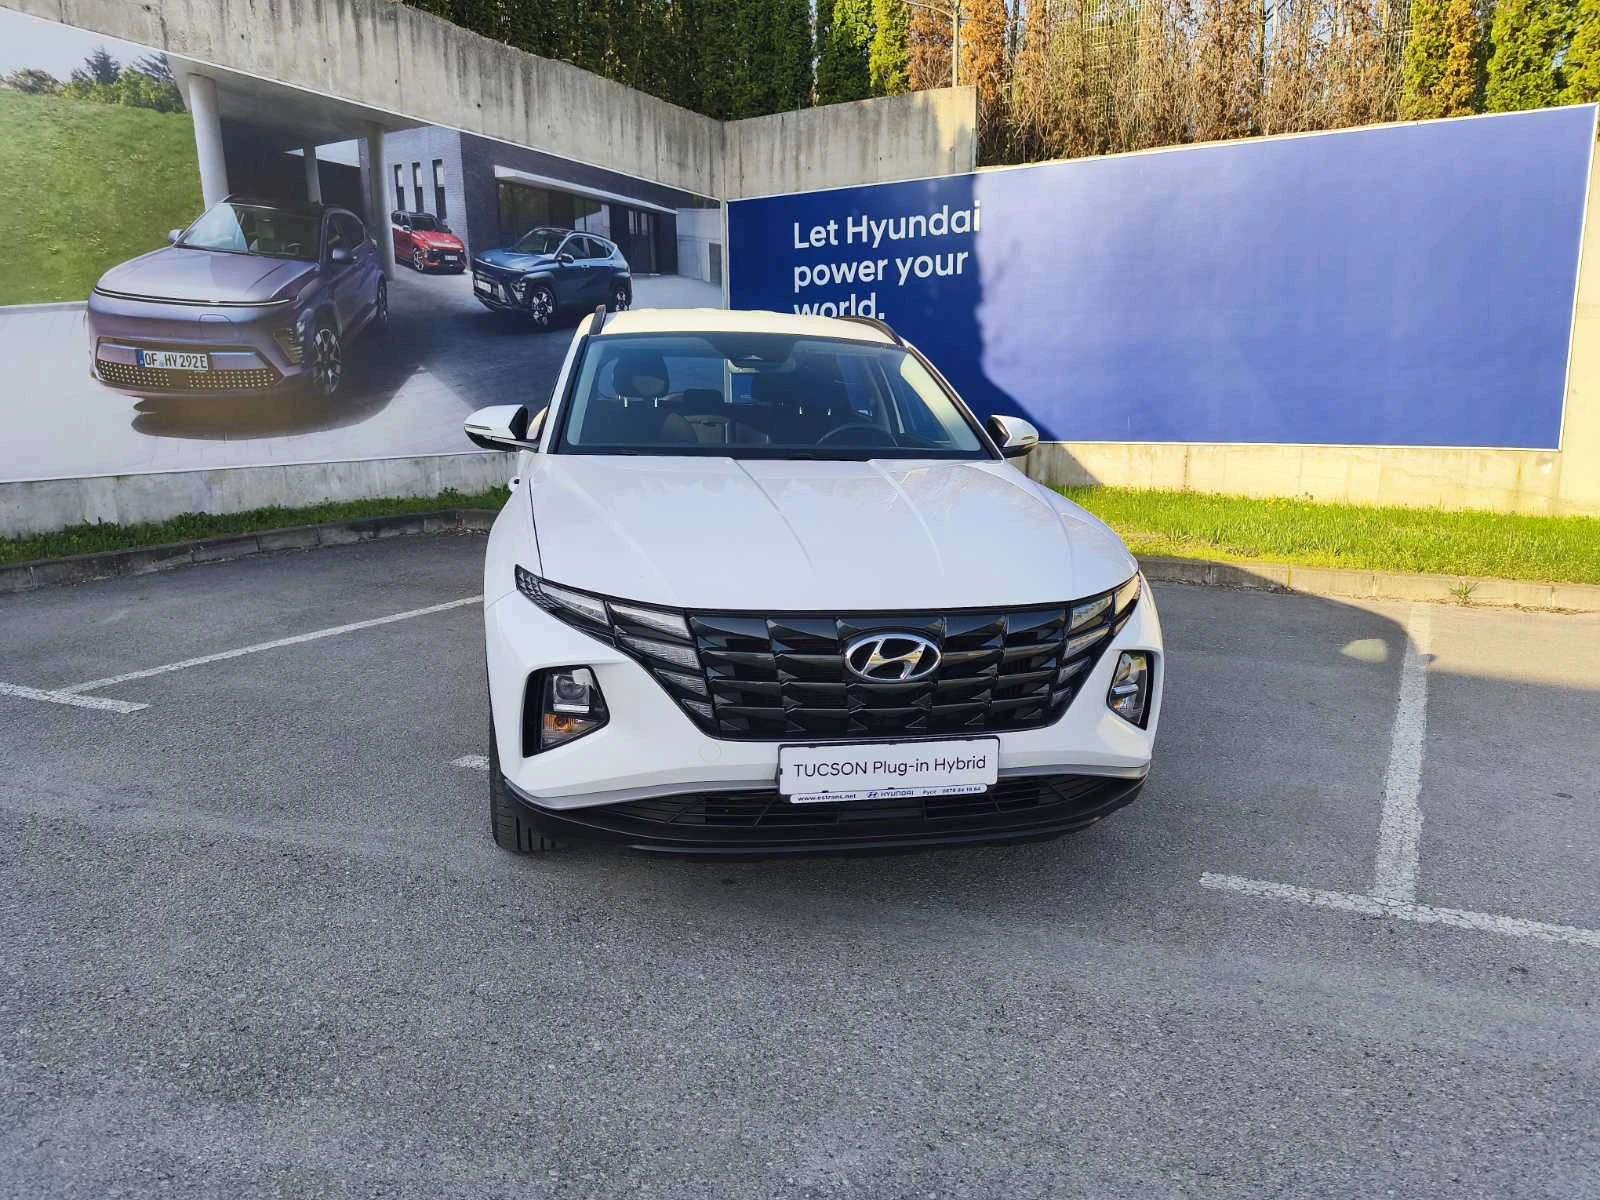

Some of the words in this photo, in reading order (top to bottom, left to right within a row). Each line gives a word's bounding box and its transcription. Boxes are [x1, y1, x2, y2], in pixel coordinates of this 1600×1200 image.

[793, 219, 839, 249] Let
[846, 199, 982, 249] Hyundai
[793, 258, 889, 294] power
[895, 251, 969, 287] your
[793, 292, 886, 320] world.
[144, 352, 158, 366] OF
[794, 760, 868, 777] TUCSON
[873, 757, 929, 777] Plug-in
[934, 755, 986, 774] Hybrid
[880, 789, 915, 798] HYUNDAI
